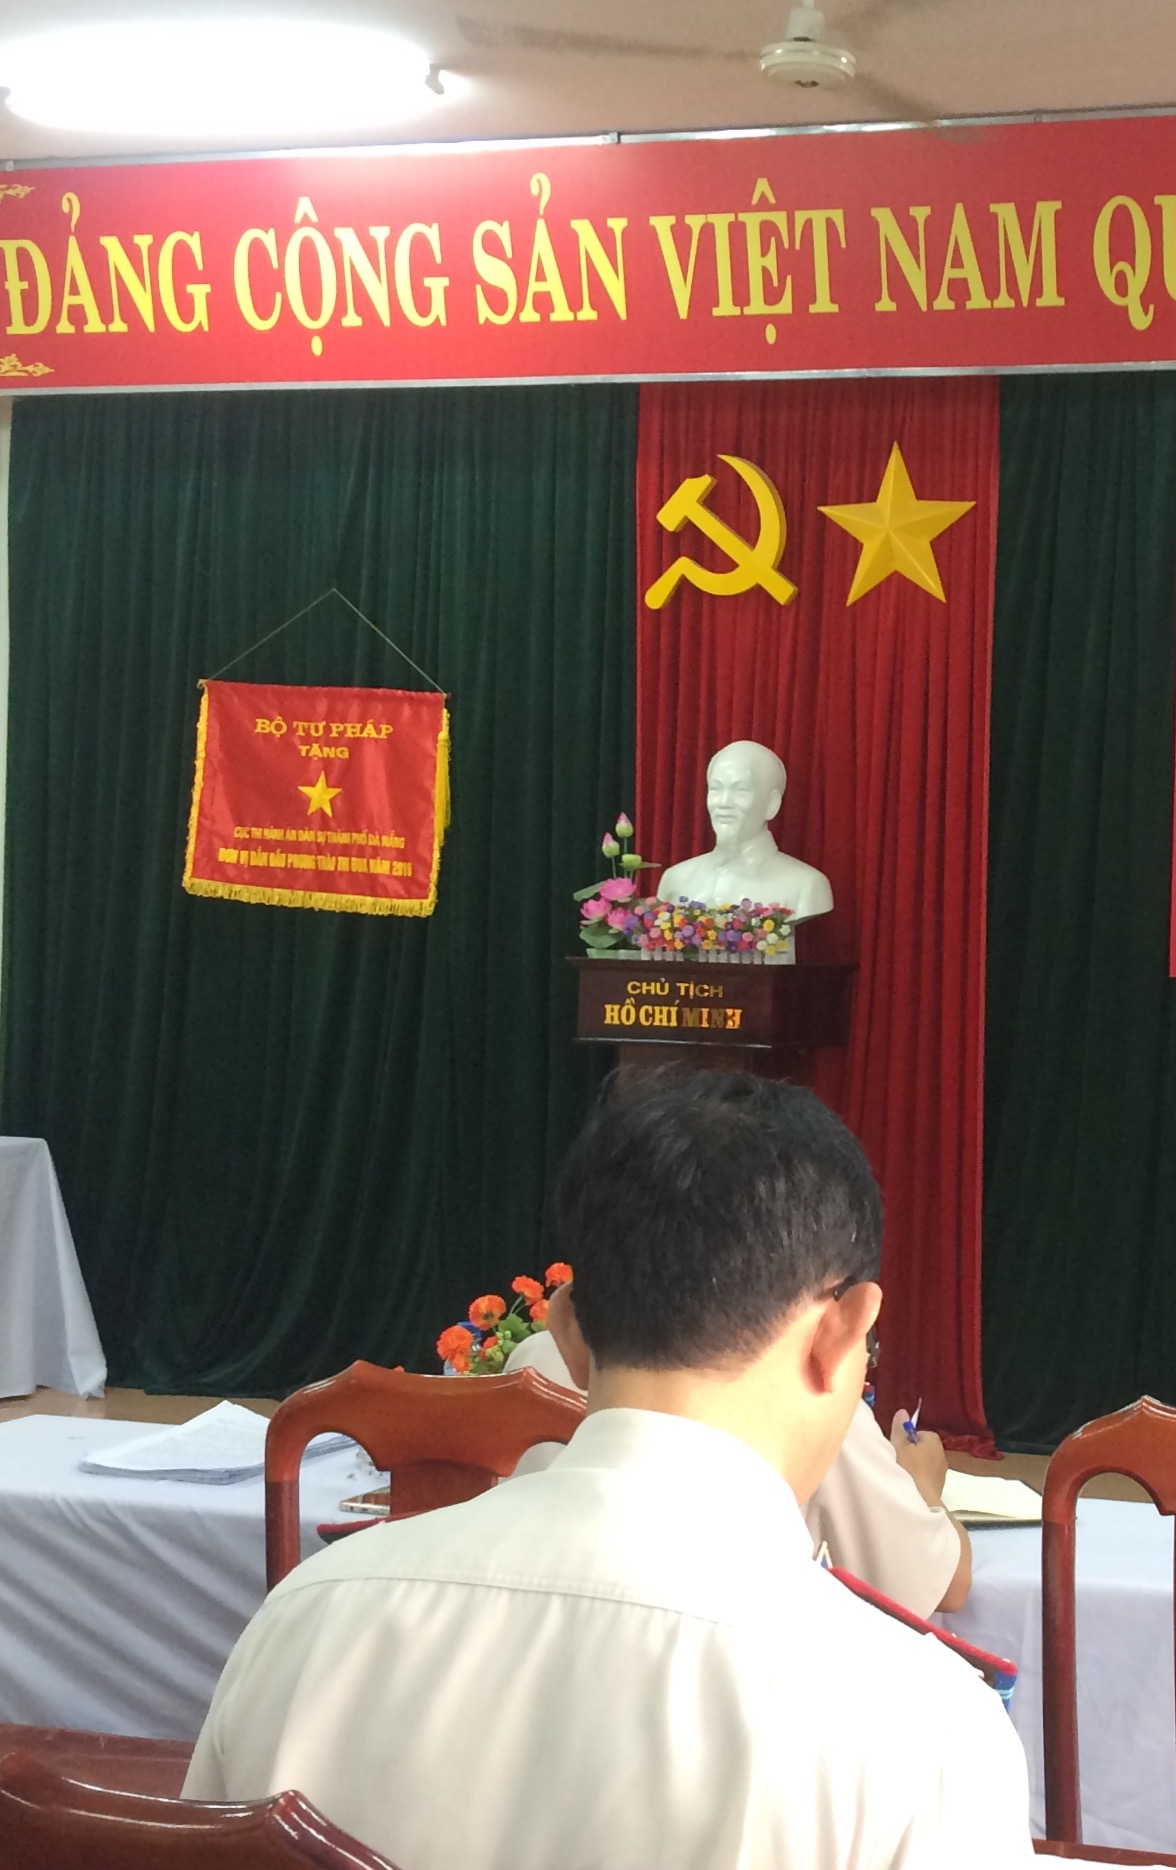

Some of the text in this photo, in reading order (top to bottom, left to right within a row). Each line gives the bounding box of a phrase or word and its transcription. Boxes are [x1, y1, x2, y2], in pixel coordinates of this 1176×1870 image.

[0, 192, 211, 336] ĐẢNG
[234, 197, 449, 357] CỘNG
[472, 172, 628, 325] SẢN
[650, 177, 846, 345] VIỆT
[871, 200, 1065, 312] NAM
[254, 715, 394, 739] BỘ TƯ PHÁP
[298, 743, 350, 760] TẶNG
[627, 978, 724, 999] CHỦ TỊCH
[604, 996, 636, 1026] HỒ
[639, 999, 679, 1027] CHÍ
